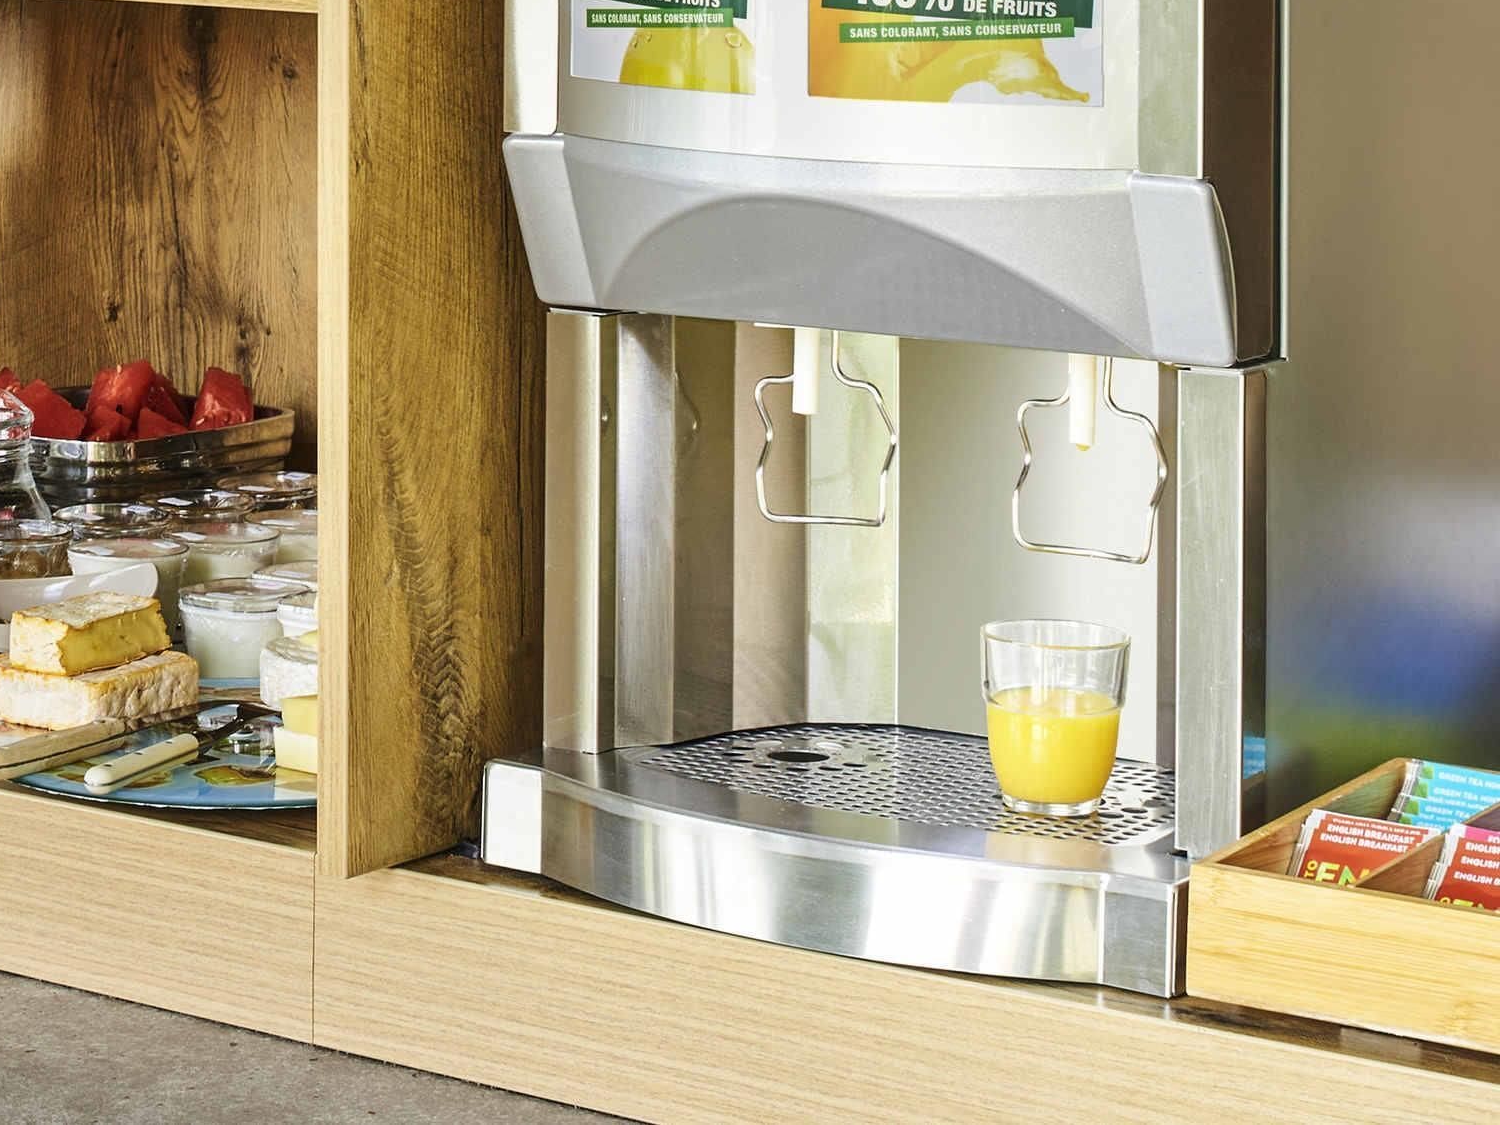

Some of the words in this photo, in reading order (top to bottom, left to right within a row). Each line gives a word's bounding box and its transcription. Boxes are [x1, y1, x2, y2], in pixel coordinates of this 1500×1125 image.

[992, 0, 1057, 17] FRUITS
[592, 13, 607, 23] SANS
[643, 13, 662, 24] SANS
[663, 13, 724, 23] CONSERVATEUR
[850, 28, 877, 38] SANS
[881, 26, 939, 39] COLORANT,
[942, 25, 972, 37] SANS
[975, 22, 1062, 35] CONSERVATEUR
[1327, 824, 1365, 836] ENGLISH
[1364, 828, 1415, 843] BREAKFAST
[1320, 832, 1357, 845] ENGLISH
[1357, 837, 1409, 853] BREAKFAST
[1453, 871, 1493, 885] ENGLISH
